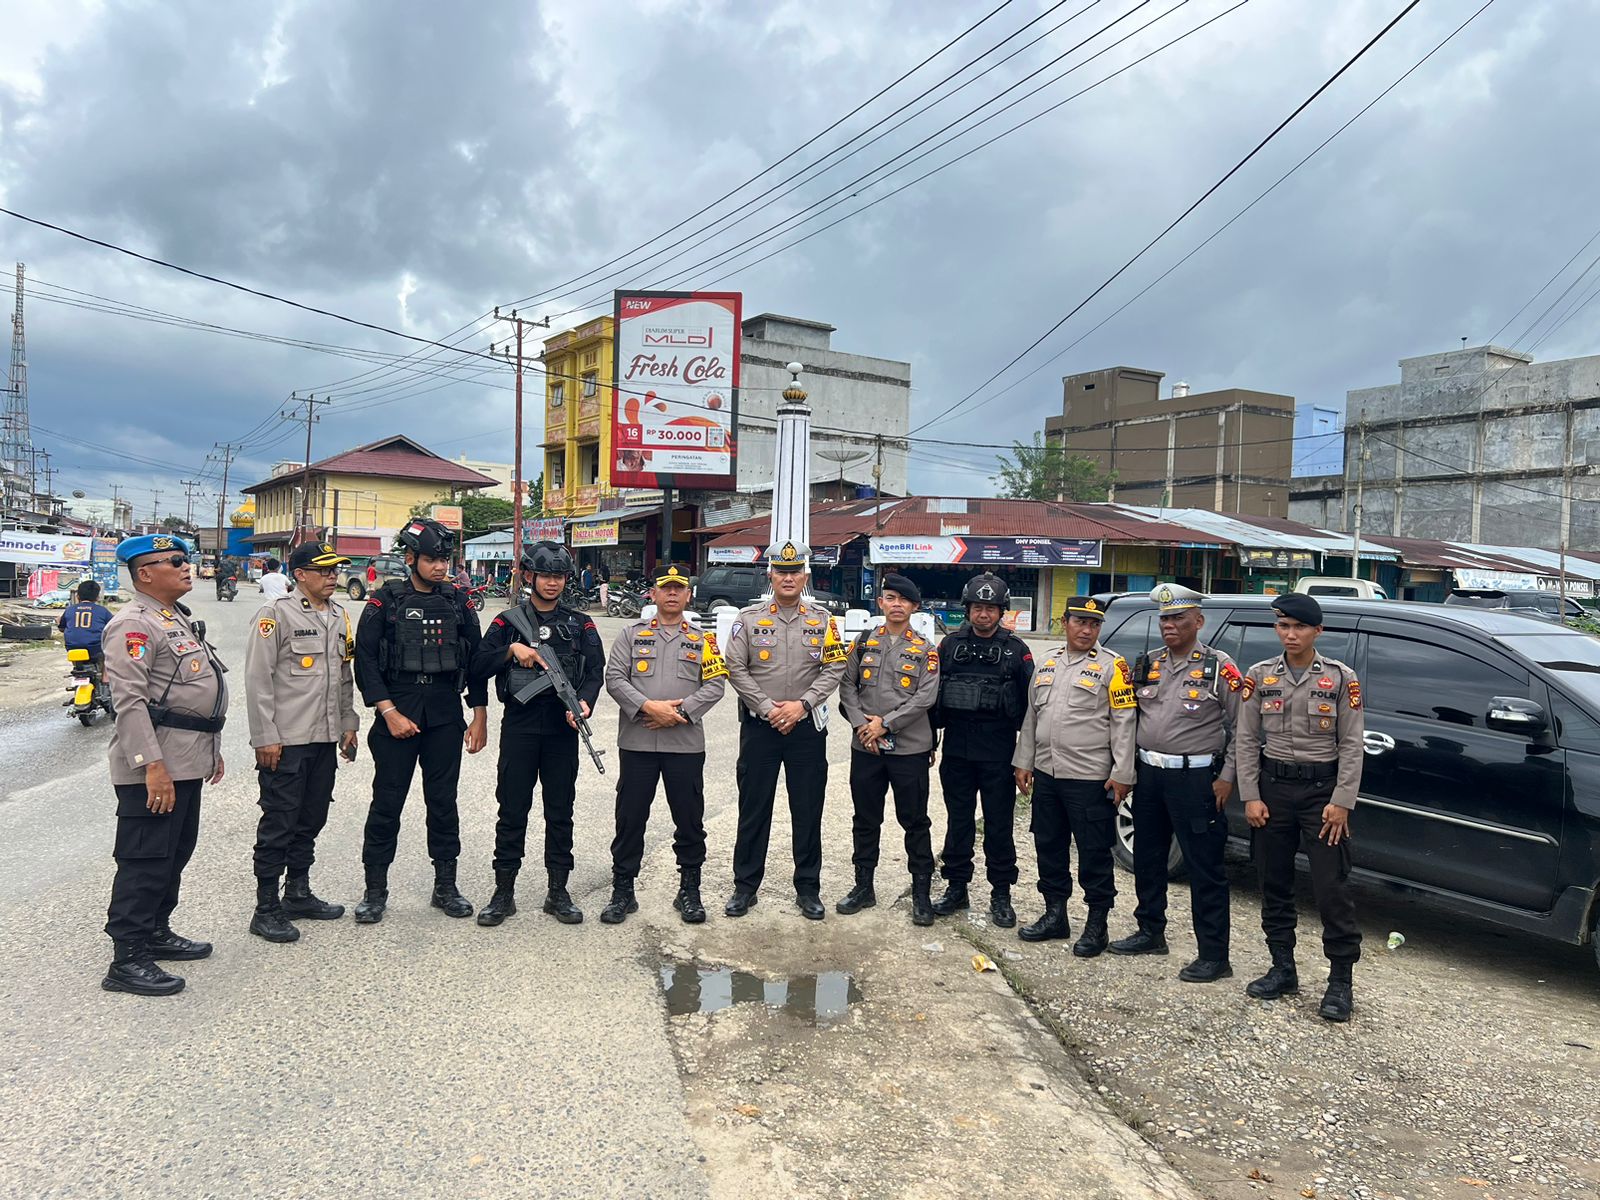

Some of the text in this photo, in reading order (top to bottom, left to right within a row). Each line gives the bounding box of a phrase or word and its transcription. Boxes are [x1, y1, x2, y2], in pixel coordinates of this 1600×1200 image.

[626, 300, 652, 310] NEW
[645, 334, 707, 344] MLD
[625, 353, 726, 385] Fresh Cola
[627, 428, 638, 437] 16
[658, 430, 702, 441] 30.000
[594, 528, 614, 537] MOTOR
[879, 543, 933, 552] AgenBRILink
[1570, 582, 1589, 593] PONSEL
[75, 611, 92, 628] 10
[680, 642, 704, 651] POLRI
[900, 653, 921, 662] POLRI
[1080, 670, 1102, 680] POLRI
[1183, 680, 1209, 688] POLRI
[1310, 690, 1337, 700] POLRI
